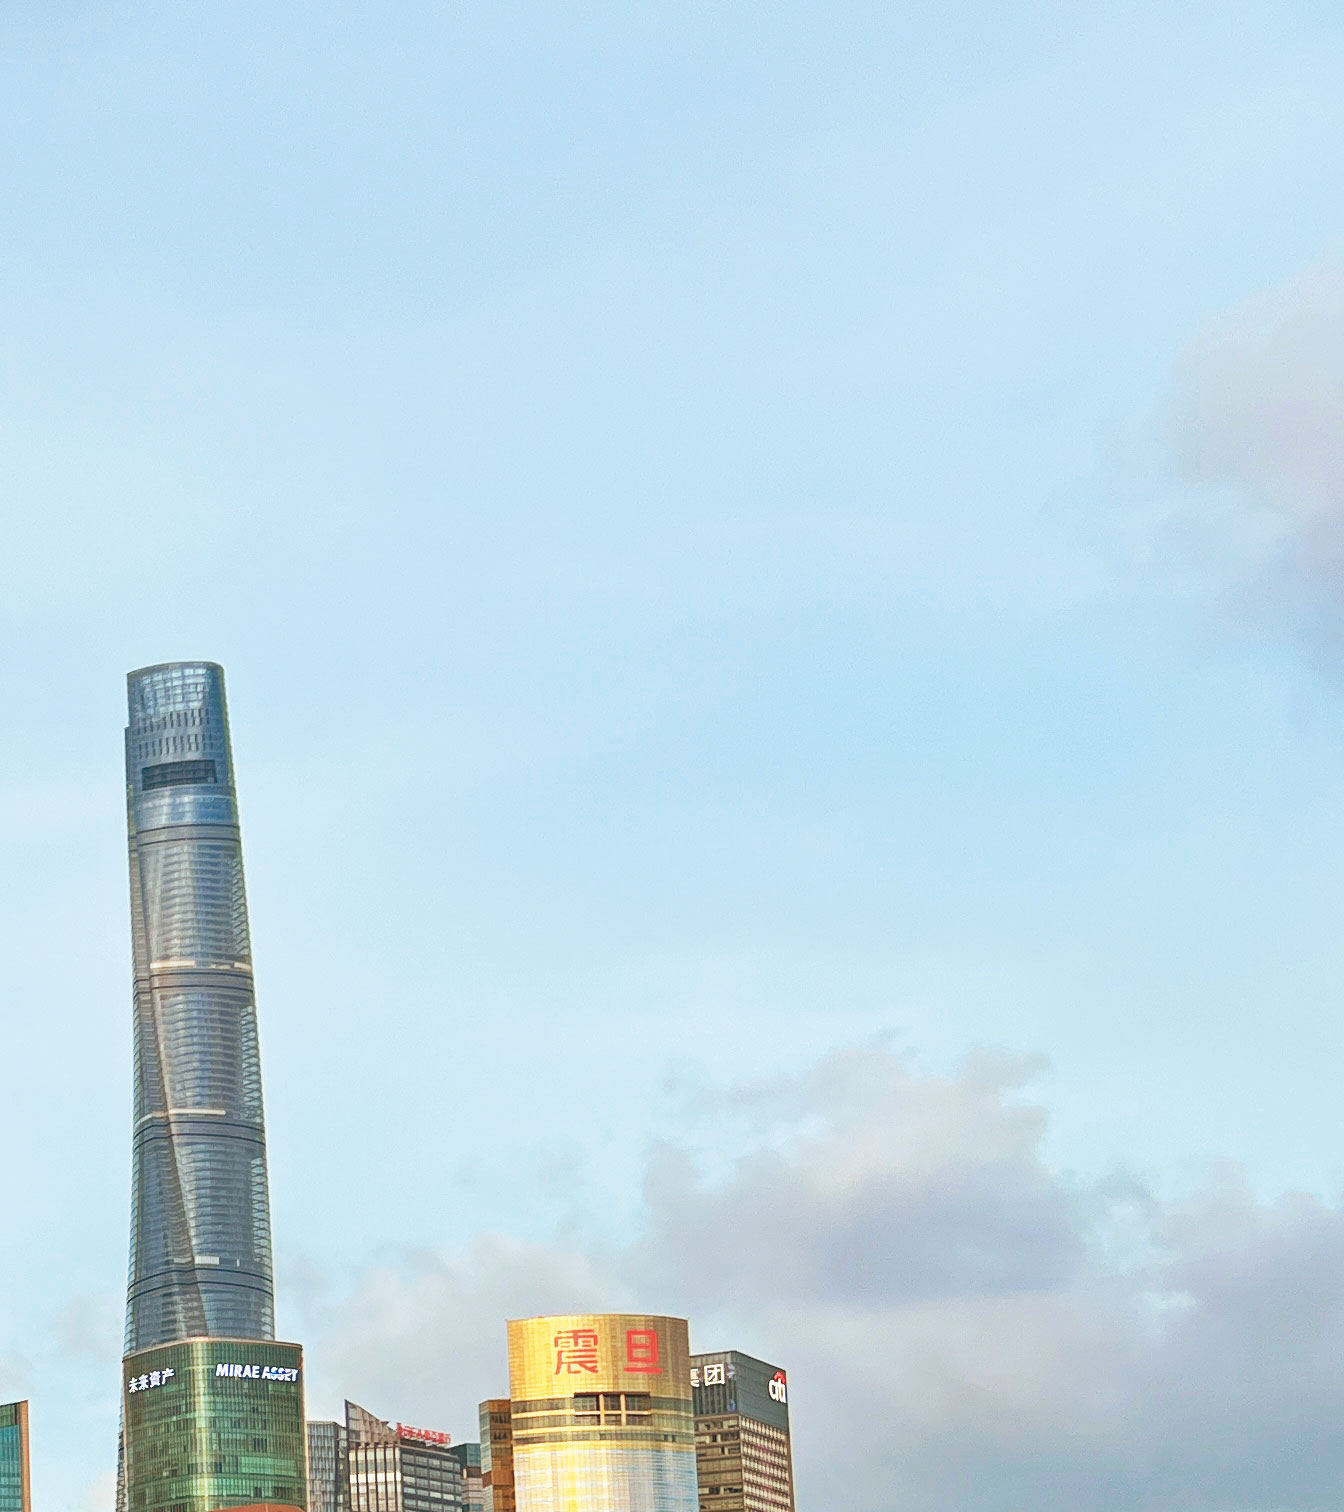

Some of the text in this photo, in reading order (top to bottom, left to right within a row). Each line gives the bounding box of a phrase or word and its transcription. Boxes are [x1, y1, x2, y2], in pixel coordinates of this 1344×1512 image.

[554, 1328, 662, 1376] 震旦
[215, 1363, 298, 1382] MIRAE ASSET
